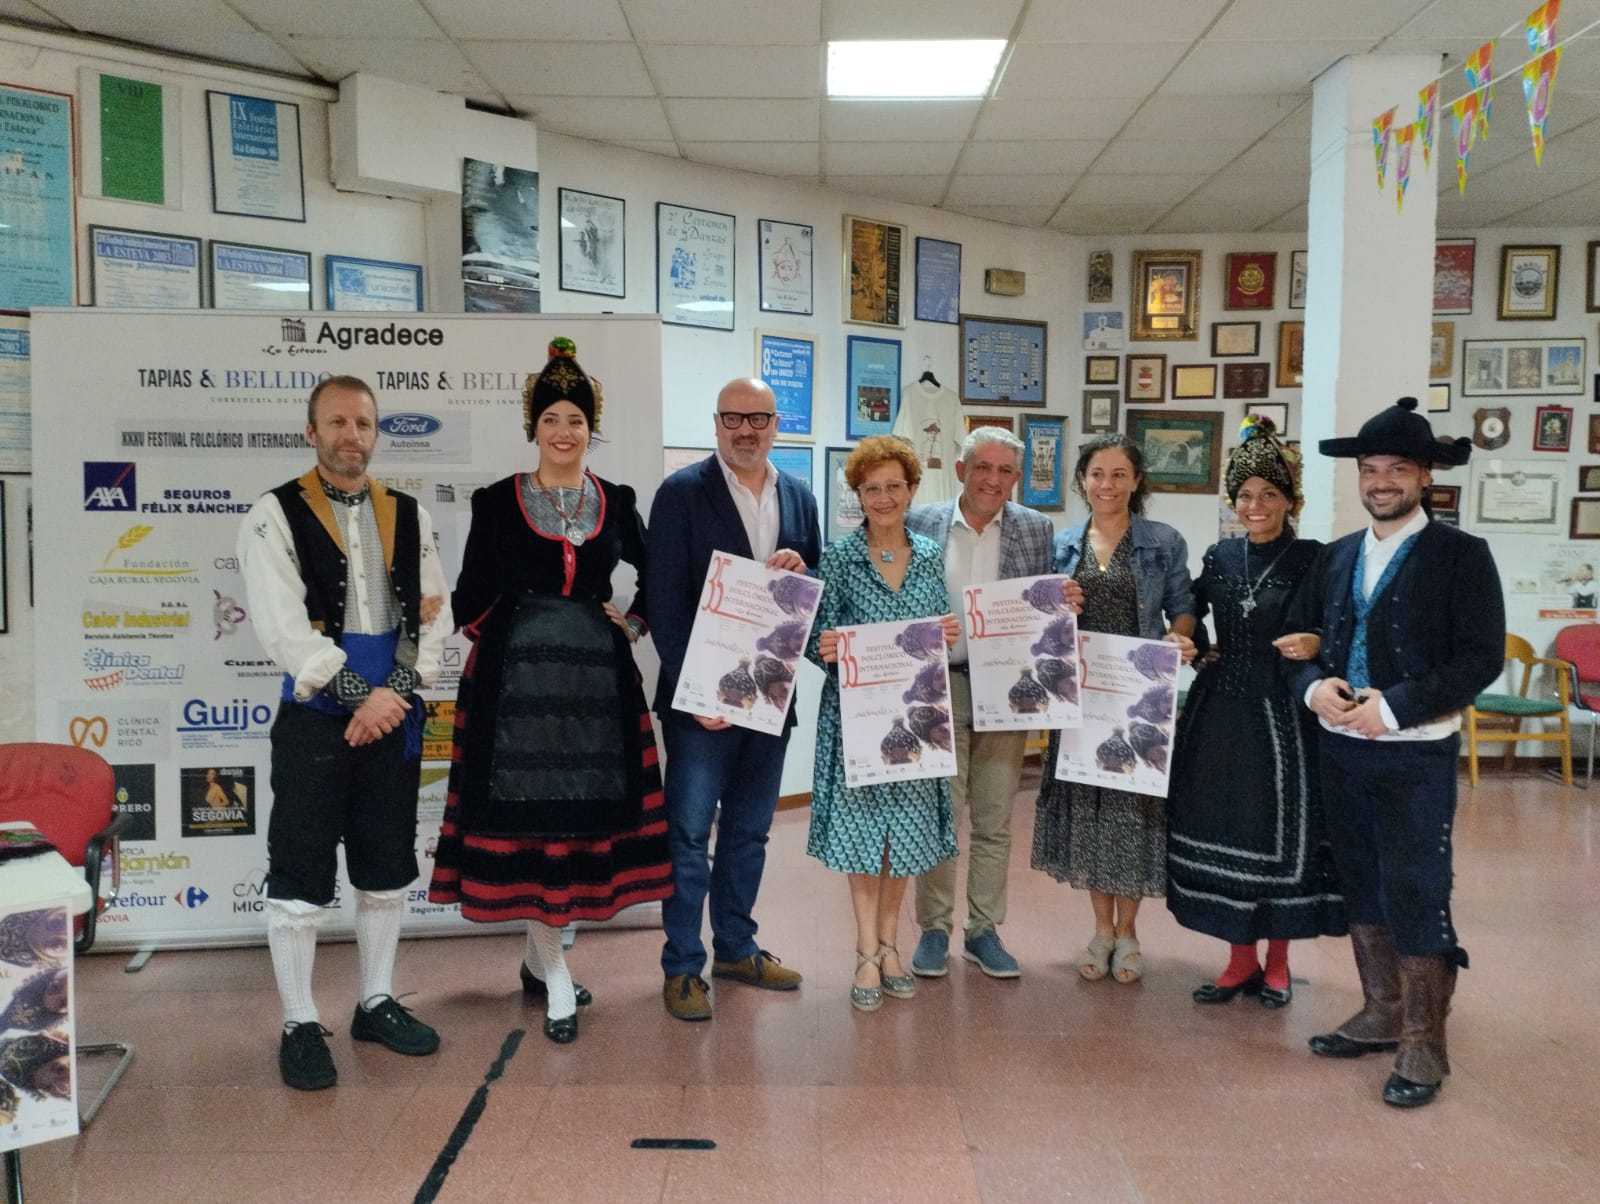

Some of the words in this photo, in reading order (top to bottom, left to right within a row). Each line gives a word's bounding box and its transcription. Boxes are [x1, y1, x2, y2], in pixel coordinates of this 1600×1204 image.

[231, 101, 247, 120] IX
[317, 321, 444, 350] Agradece
[138, 369, 192, 388] TAPIAS
[200, 369, 217, 388] &
[376, 371, 430, 390] TAPIAS
[437, 371, 454, 390] &
[463, 371, 529, 390] BELL
[389, 415, 430, 433] Ford
[121, 431, 145, 448] XXXV
[147, 431, 188, 448] FESTIVAL
[190, 429, 243, 448] FOLCLÓRICO
[247, 432, 315, 449] INTERNACION
[390, 439, 431, 449] Autoinsa
[84, 486, 129, 507] AXA
[163, 489, 232, 500] SEGUROS
[141, 501, 183, 513] FÉLIX
[123, 559, 190, 568] Fundación
[88, 576, 115, 585] CAJA
[117, 576, 151, 584] RURAL
[153, 576, 201, 584] SEGOVIA
[702, 556, 733, 614] 35
[82, 610, 121, 628] Calor
[122, 610, 191, 628] Industrial
[966, 588, 985, 640] 35
[839, 631, 858, 689] 35
[1078, 634, 1091, 688] 5
[125, 663, 185, 680] Dental
[183, 698, 272, 731] Guijo
[117, 728, 158, 736] DENTAL
[117, 738, 143, 746] RICO
[192, 810, 244, 822] SEGOVIA
[409, 905, 445, 915] Segovia
